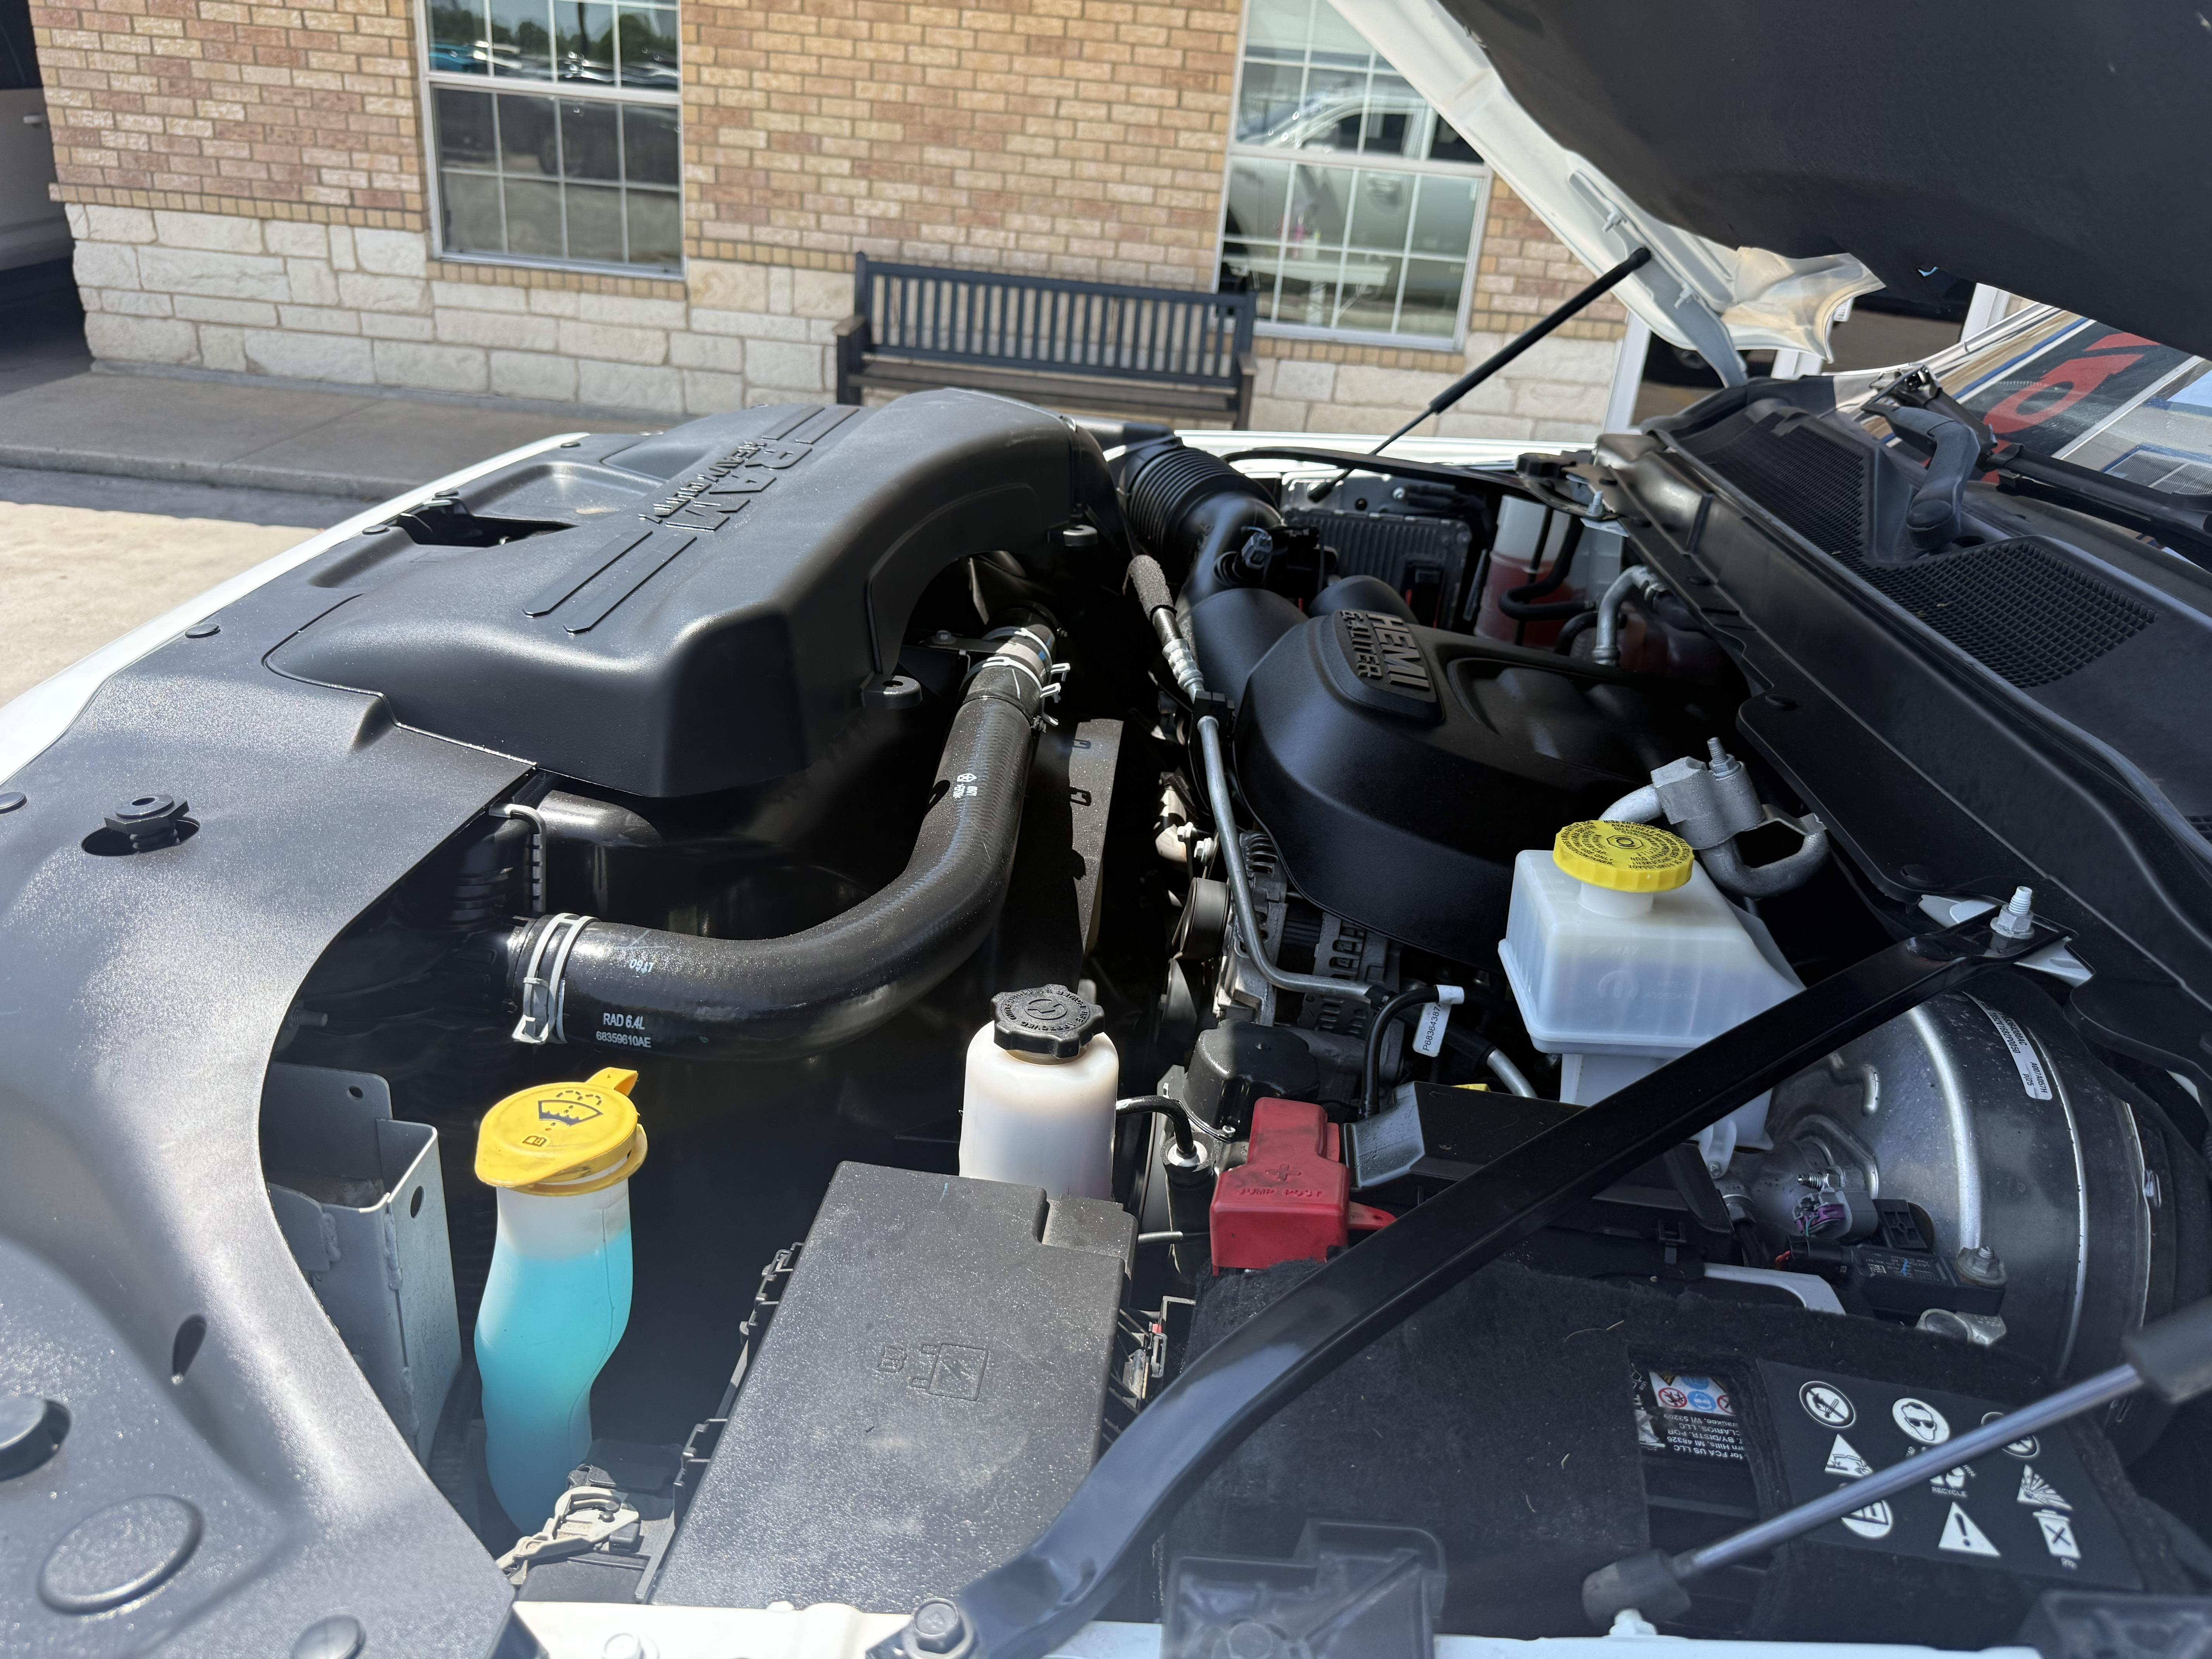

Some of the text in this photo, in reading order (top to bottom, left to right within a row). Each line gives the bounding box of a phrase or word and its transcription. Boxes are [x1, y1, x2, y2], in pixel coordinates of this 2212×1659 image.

[697, 440, 768, 483] HEAVY
[665, 443, 812, 532] RAM
[1349, 630, 1383, 680] LITER
[1366, 613, 1431, 692] HEMI
[603, 1012, 646, 1030] RAD 6.4L
[596, 1030, 652, 1048] 68359610AE
[1240, 1187, 1323, 1197] JUMP POST
[1708, 1449, 1728, 1458] FCA
[1931, 1486, 1967, 1497] RECYCLE
